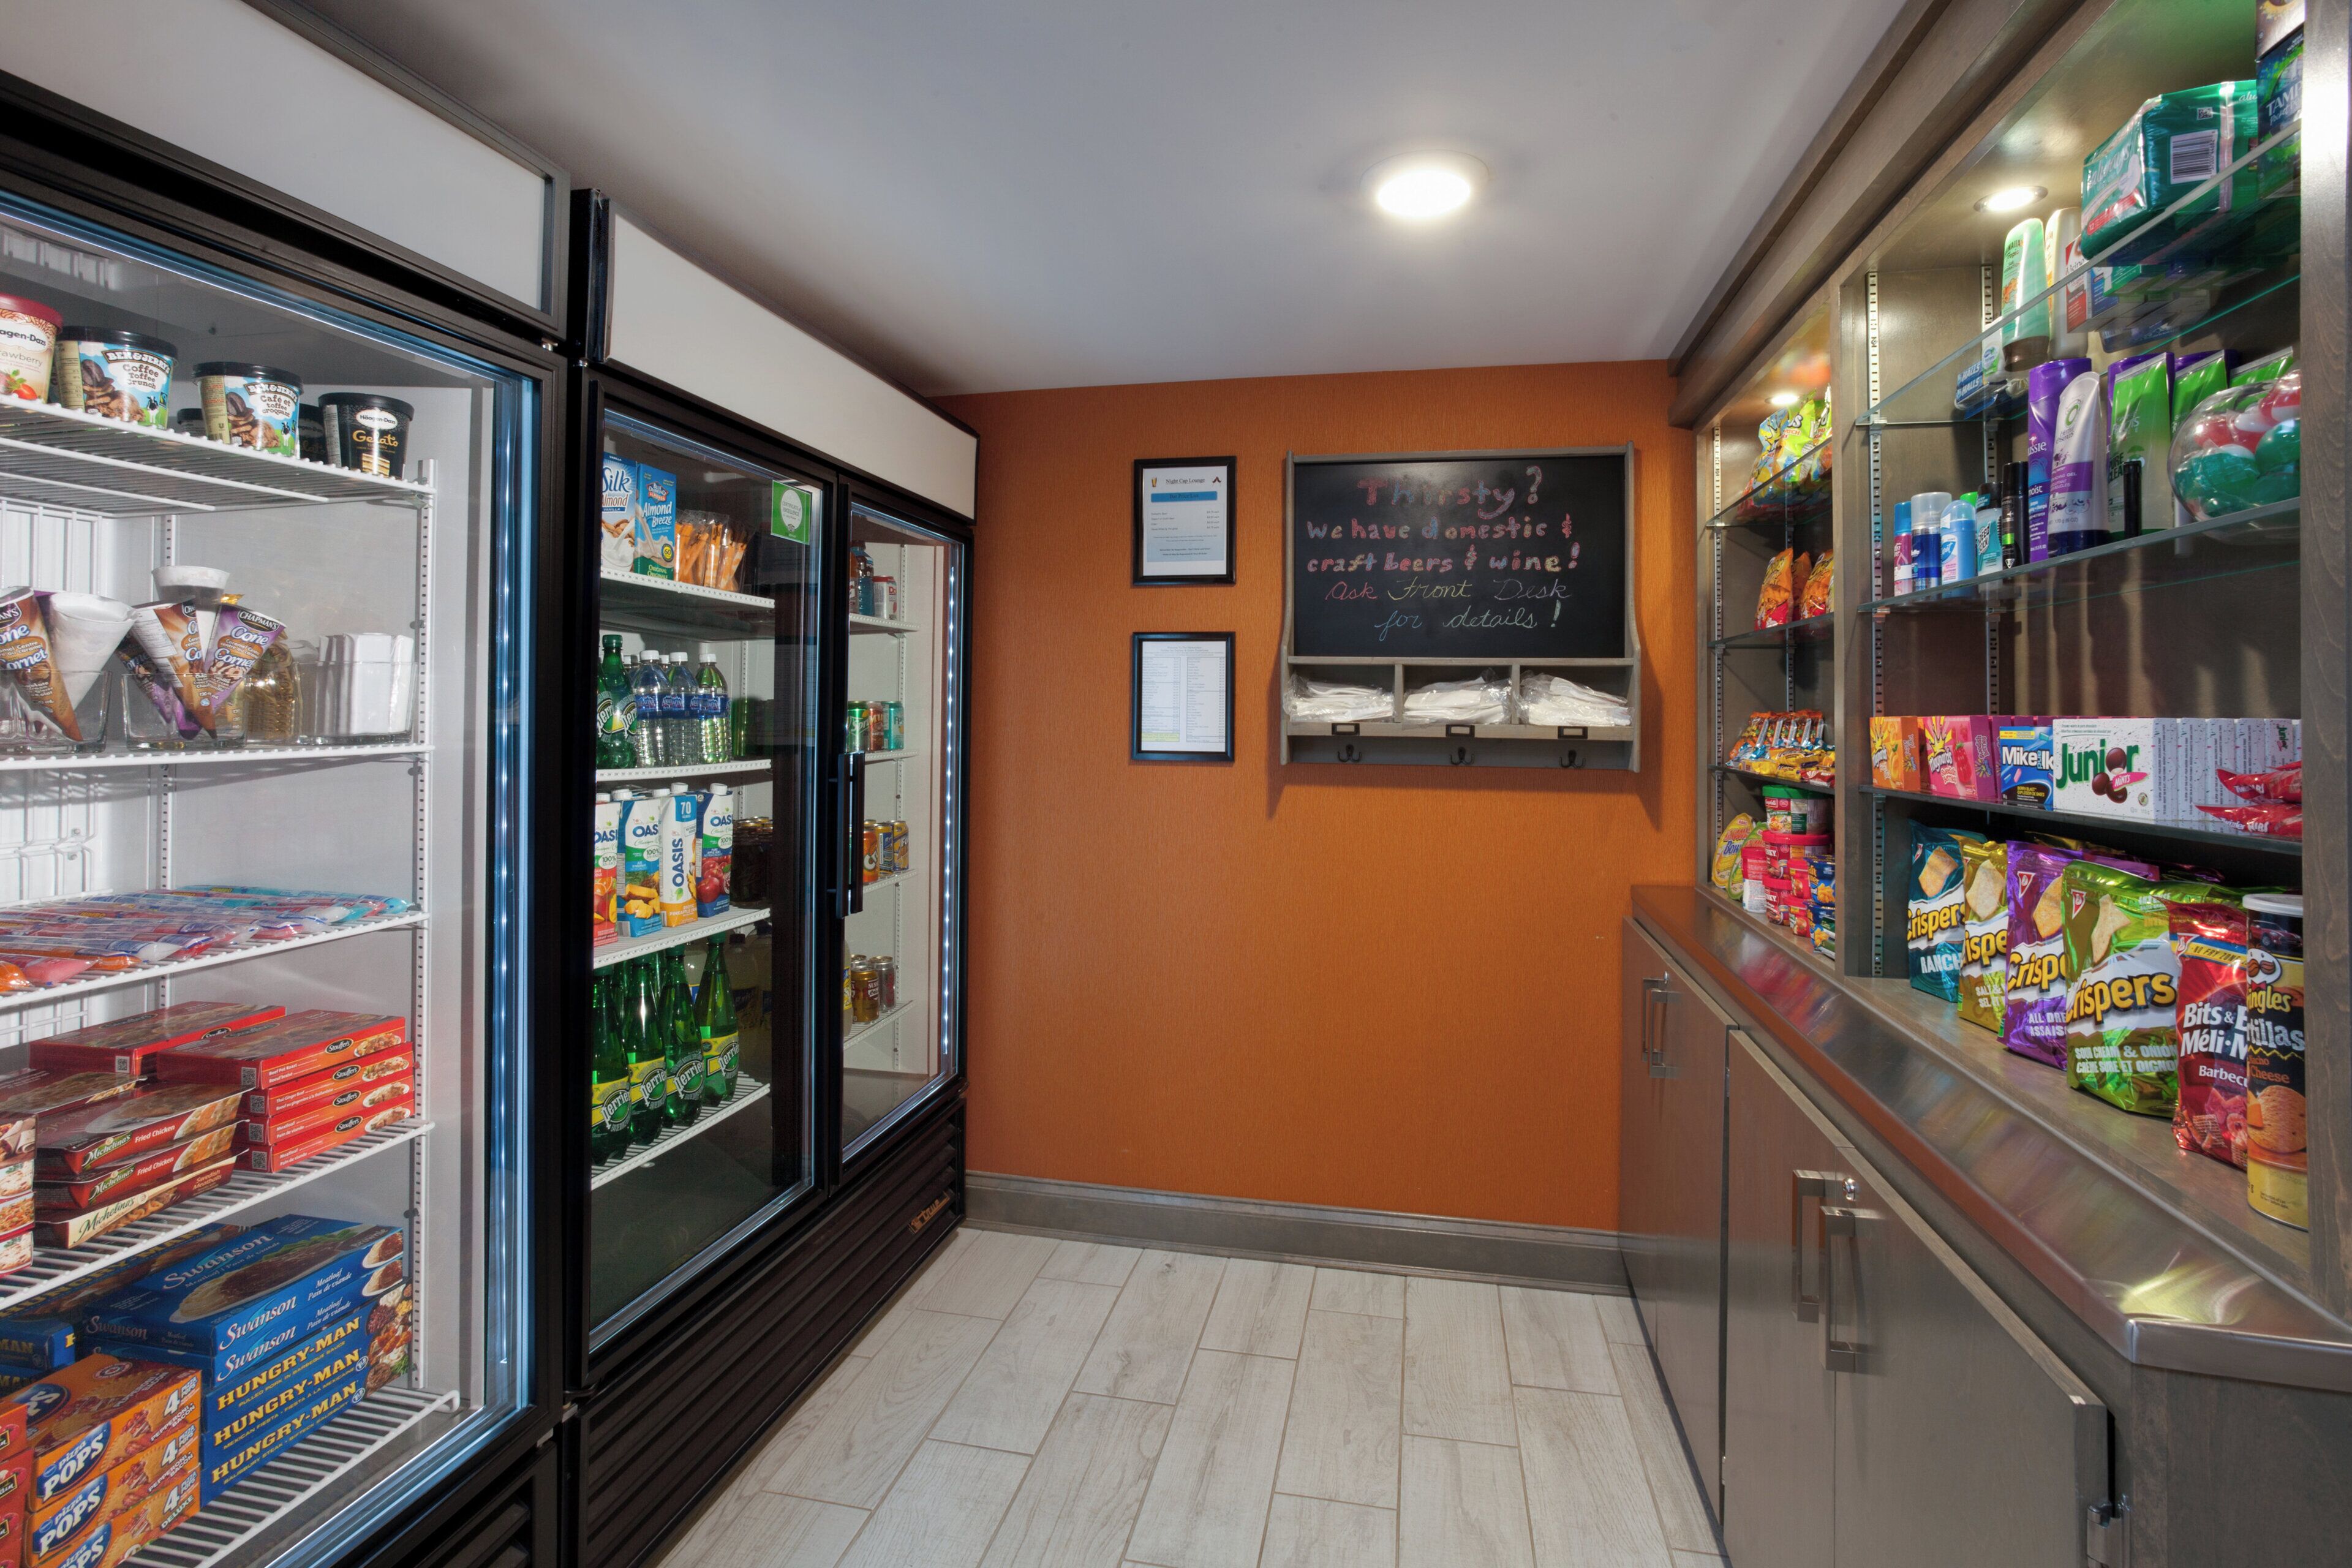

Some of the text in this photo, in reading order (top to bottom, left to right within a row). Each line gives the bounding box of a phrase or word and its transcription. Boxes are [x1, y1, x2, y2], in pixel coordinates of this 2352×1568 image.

[0, 329, 46, 346] agen-Dazs
[0, 350, 43, 366] rawberry
[123, 364, 159, 378] Coffee
[129, 372, 156, 382] Toffee
[1962, 363, 1981, 379] HALLS
[1961, 377, 1980, 397] HALLS
[643, 502, 673, 518] Almond
[652, 516, 672, 527] Breeze
[1351, 518, 1411, 540] have
[1421, 515, 1548, 540] domestic
[1306, 553, 1376, 573] craft
[1384, 551, 1453, 573] beers
[1387, 576, 1472, 600] Front
[1493, 578, 1572, 600] Desk
[239, 611, 279, 630] CHAPMAN'S
[1374, 609, 1423, 641] for
[232, 626, 269, 645] Cone
[2002, 746, 2037, 766] Mike
[2042, 751, 2053, 770] Ik
[680, 801, 692, 815] 70
[633, 826, 658, 837] OAS
[672, 837, 685, 888] OASIS
[2206, 948, 2220, 957] FRY
[2008, 951, 2066, 993] Crisp
[1978, 998, 1991, 1008] SEL
[2029, 1012, 2043, 1023] ALL
[2183, 1000, 2223, 1028] Bits
[2224, 1011, 2234, 1024] &
[328, 1041, 352, 1052] Stouffer's
[2093, 1046, 2121, 1058] CREAM
[2124, 1045, 2138, 1058] &
[335, 1067, 360, 1079] Stouffer's
[2121, 1060, 2133, 1072] ET
[2136, 1060, 2176, 1072] OIGNO
[2249, 1065, 2290, 1083] Cheese
[336, 1093, 360, 1104] Stouffer's
[135, 1125, 175, 1144] Fried Chicken
[338, 1118, 361, 1131] Stouffer's
[81, 1134, 130, 1167] Michelina's
[137, 1157, 174, 1176] Fried Chicken
[197, 1169, 221, 1183] Swedish
[89, 1166, 134, 1200] Michelina's
[74, 1197, 135, 1244] Michelina's
[163, 1232, 274, 1290] Swanson
[316, 1268, 343, 1287] Meatloaf
[307, 1287, 322, 1302] Pain
[315, 1297, 343, 1318] Meatloaf
[219, 1294, 298, 1352] Swanson
[216, 1324, 297, 1382] Swanson
[217, 1316, 360, 1411] HUNGRY-MAN
[163, 1389, 180, 1416] 4
[214, 1348, 360, 1447] HUNGRY-MAN
[151, 1405, 189, 1442] PEPPERONI
[172, 1405, 196, 1429] BACON
[212, 1381, 358, 1483] HUNGRY-MAN
[58, 1440, 86, 1469] pizza
[161, 1439, 178, 1467] 4
[262, 1442, 283, 1458] STEAK
[42, 1430, 105, 1501] POPS
[148, 1455, 187, 1493] PEPPERONI
[169, 1453, 194, 1477] BACON
[55, 1493, 83, 1522] pizza
[163, 1486, 179, 1513] 4
[38, 1485, 101, 1557] POPS
[160, 1494, 195, 1529] DELUXE
